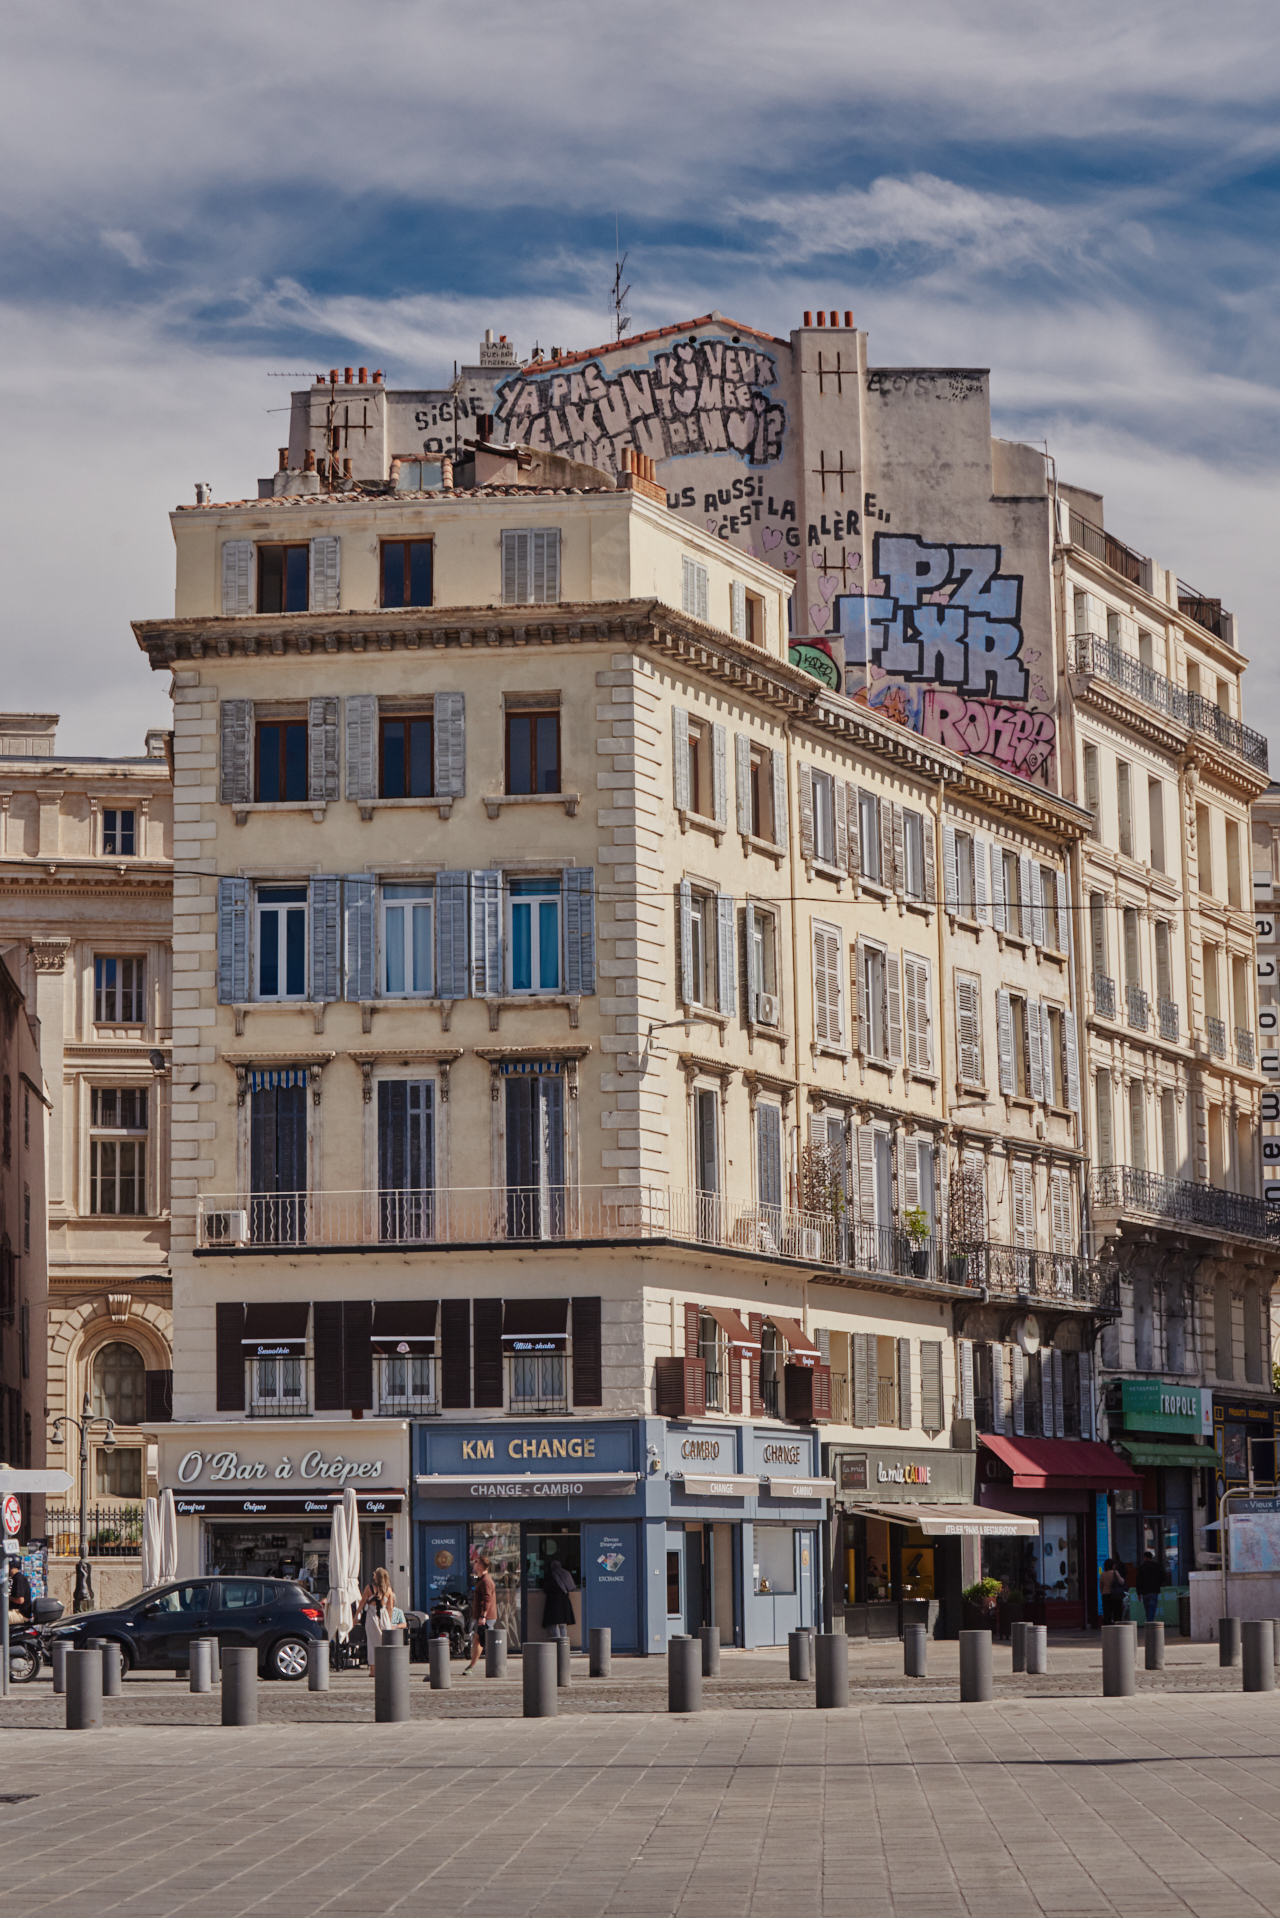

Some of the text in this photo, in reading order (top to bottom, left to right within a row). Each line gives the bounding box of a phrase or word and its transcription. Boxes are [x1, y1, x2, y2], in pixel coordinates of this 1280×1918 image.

[550, 362, 606, 406] PAS
[768, 496, 796, 522] LA
[513, 1341, 556, 1350] Milk-shake
[462, 1438, 596, 1460] KM CHANGE
[681, 1440, 720, 1460] CAMBIO
[763, 1444, 801, 1464] CHANGE
[274, 1456, 293, 1479] à
[300, 1450, 383, 1486] Crêpes
[877, 1461, 888, 1482] la
[888, 1462, 905, 1483] mie
[470, 1484, 523, 1496] CHANGE
[533, 1483, 584, 1495] CAMBIO
[710, 1483, 734, 1494] CHANGE
[792, 1485, 813, 1496] CAMBIO
[177, 1501, 385, 1513] Gaufres Crêpes Glaces Cafés
[1249, 1500, 1273, 1508] Vieux
[945, 1525, 964, 1534] ATELIER
[1164, 1592, 1177, 1601] BIO
